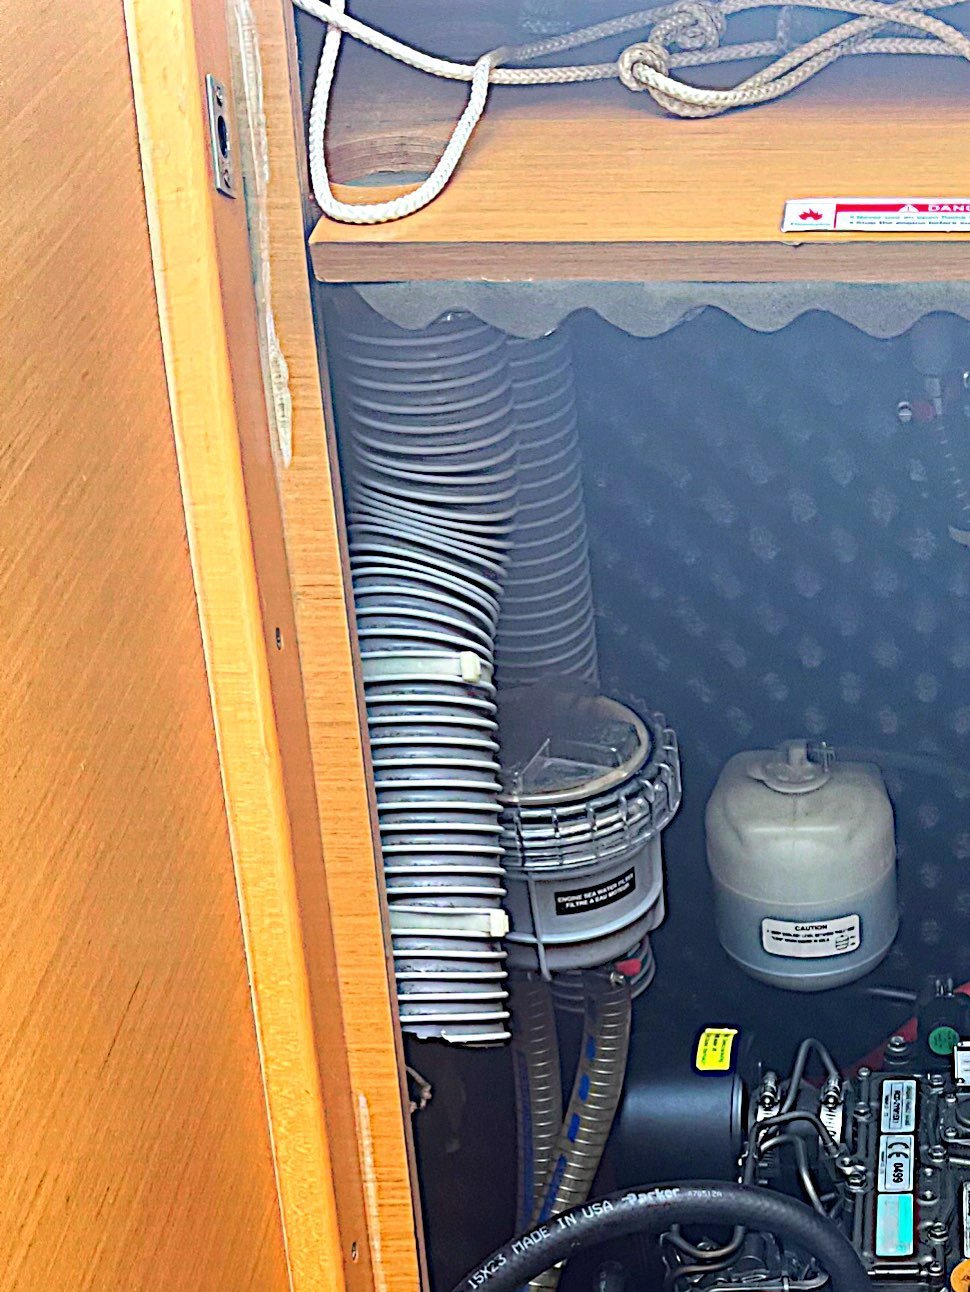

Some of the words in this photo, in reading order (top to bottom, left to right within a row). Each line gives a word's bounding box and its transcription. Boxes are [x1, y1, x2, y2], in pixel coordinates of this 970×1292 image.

[557, 894, 583, 903] ENGINE
[584, 890, 597, 899] SEA
[598, 883, 618, 895] WATER
[565, 900, 589, 909] FILTRE
[892, 1162, 904, 1184] 0499
[468, 1253, 507, 1290] 15X23
[511, 1225, 552, 1255] MADE
[557, 1213, 577, 1230] IN
[582, 1200, 614, 1219] USA
[622, 1187, 680, 1206] Parker
